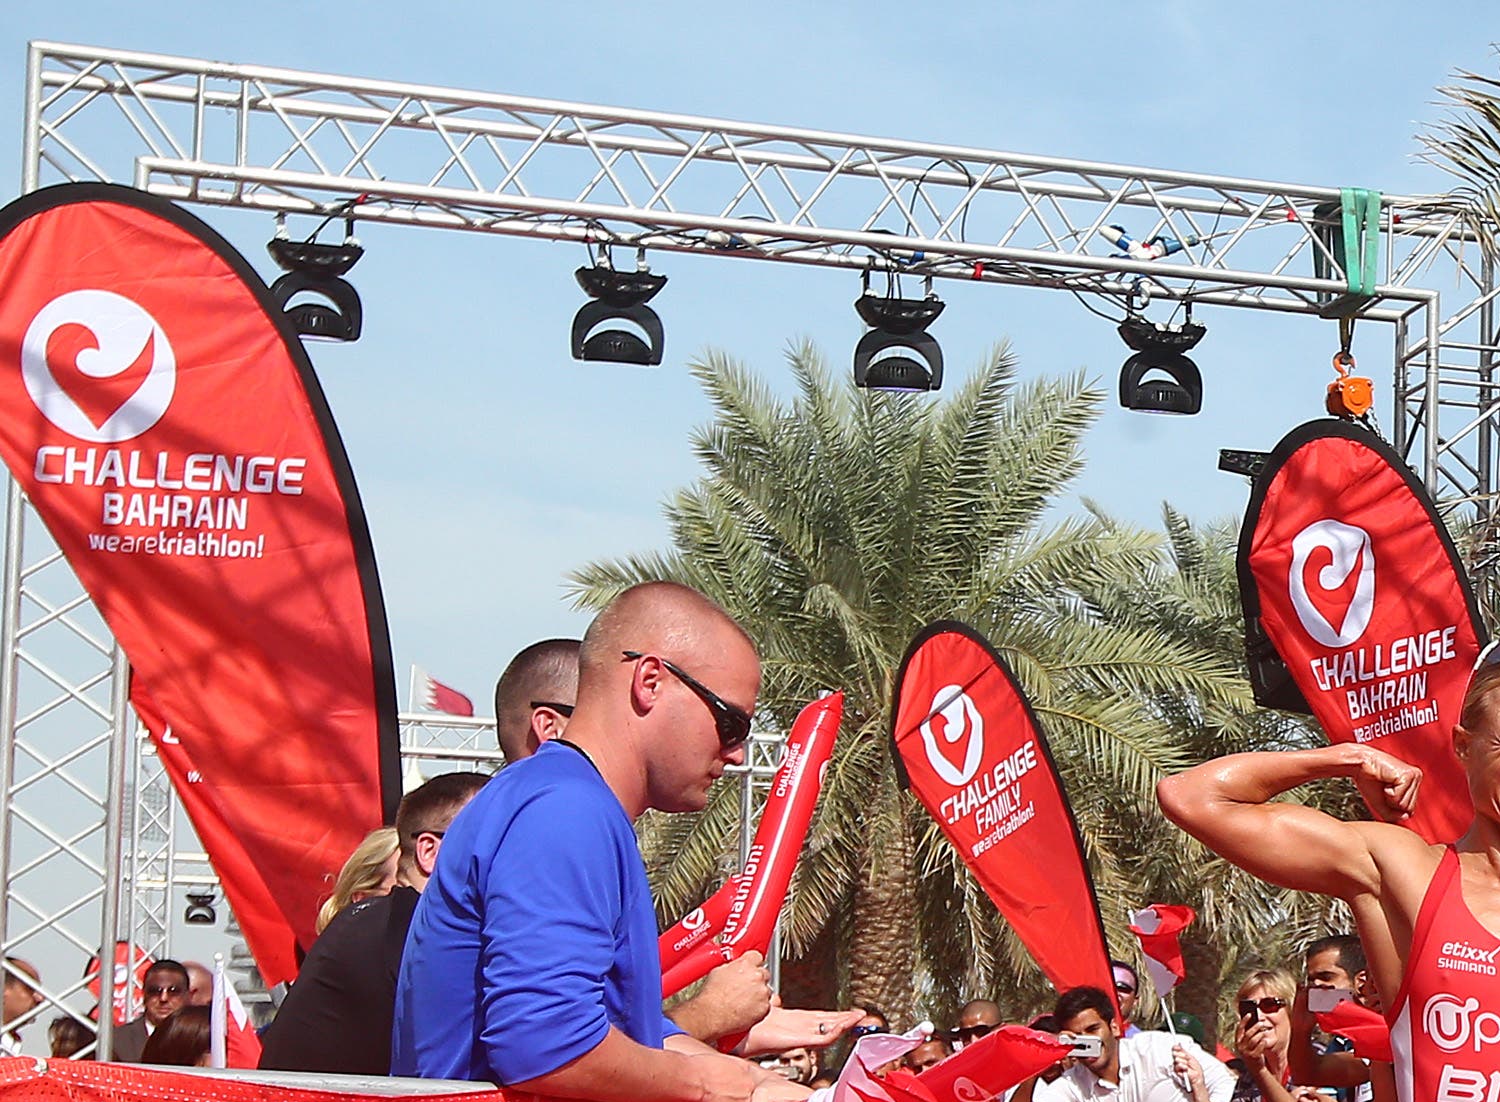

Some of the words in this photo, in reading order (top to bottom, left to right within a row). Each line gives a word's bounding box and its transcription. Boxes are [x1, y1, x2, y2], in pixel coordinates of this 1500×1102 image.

[34, 446, 306, 495] CHALLENGE
[103, 492, 248, 530] BAHRAIN
[88, 532, 265, 559] wearetriathlon!
[1310, 626, 1457, 691] CHALLENGE
[1347, 671, 1427, 720] BAHRAIN
[776, 742, 801, 797] CHALLENGE
[940, 740, 1037, 825] CHALLENGE
[975, 782, 1020, 835] FAMILY
[1437, 957, 1497, 976] SHIMANO
